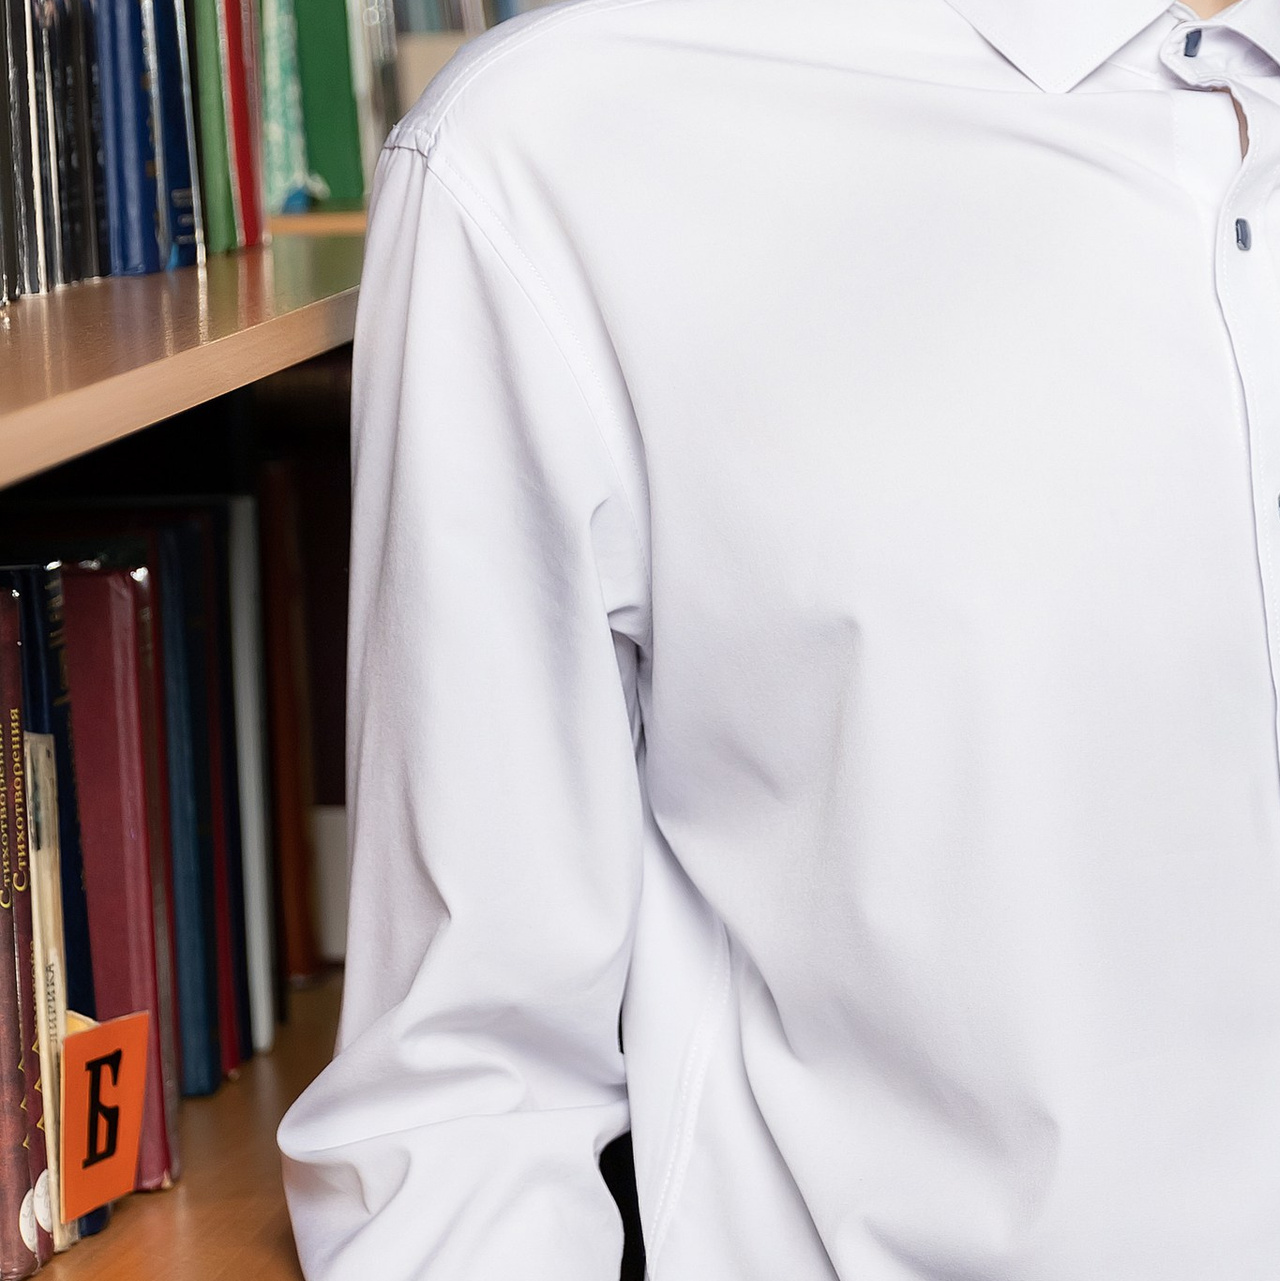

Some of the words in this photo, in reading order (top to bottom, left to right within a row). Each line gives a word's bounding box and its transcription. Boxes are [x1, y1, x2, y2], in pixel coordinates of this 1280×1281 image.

[10, 707, 28, 891] Стихотворения
[45, 961, 57, 1043] ЛИРИКА
[82, 1048, 122, 1169] Б
